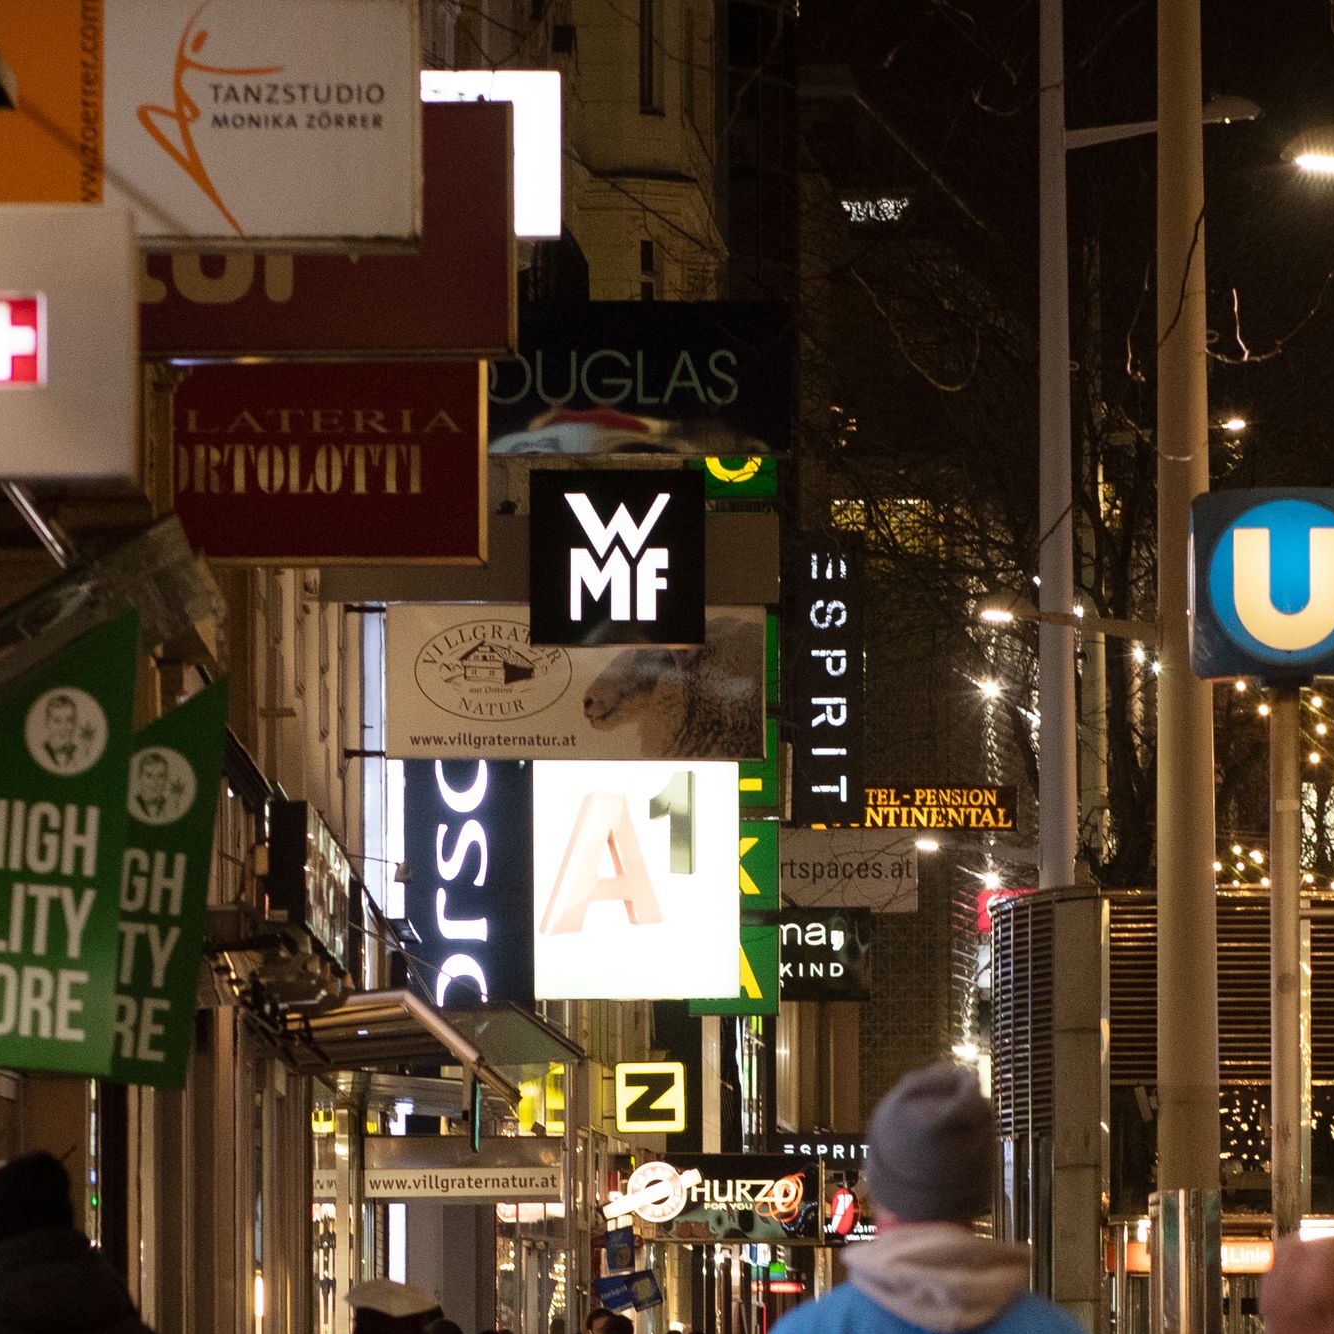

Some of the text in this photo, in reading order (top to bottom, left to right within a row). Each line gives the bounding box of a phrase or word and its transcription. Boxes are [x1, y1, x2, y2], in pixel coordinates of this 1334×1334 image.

[209, 82, 386, 105] TANZSTUDIO
[210, 110, 385, 130] MONIKA ZÖRRER
[174, 408, 465, 434] LATERIA
[564, 492, 670, 621] WMF
[422, 624, 563, 666] VILLGRATR
[810, 551, 849, 804] ESPRIT
[458, 697, 525, 717] NATUR
[409, 733, 577, 749] www.villgraternatur.at
[865, 788, 900, 806] TEL
[914, 788, 998, 806] PENSION
[864, 807, 1013, 829] NTINENTAL
[539, 769, 697, 935] A1
[779, 961, 844, 978] KIND
[369, 1172, 558, 1192] www.villgraternatur.at
[703, 1202, 753, 1211] FOR YOU
